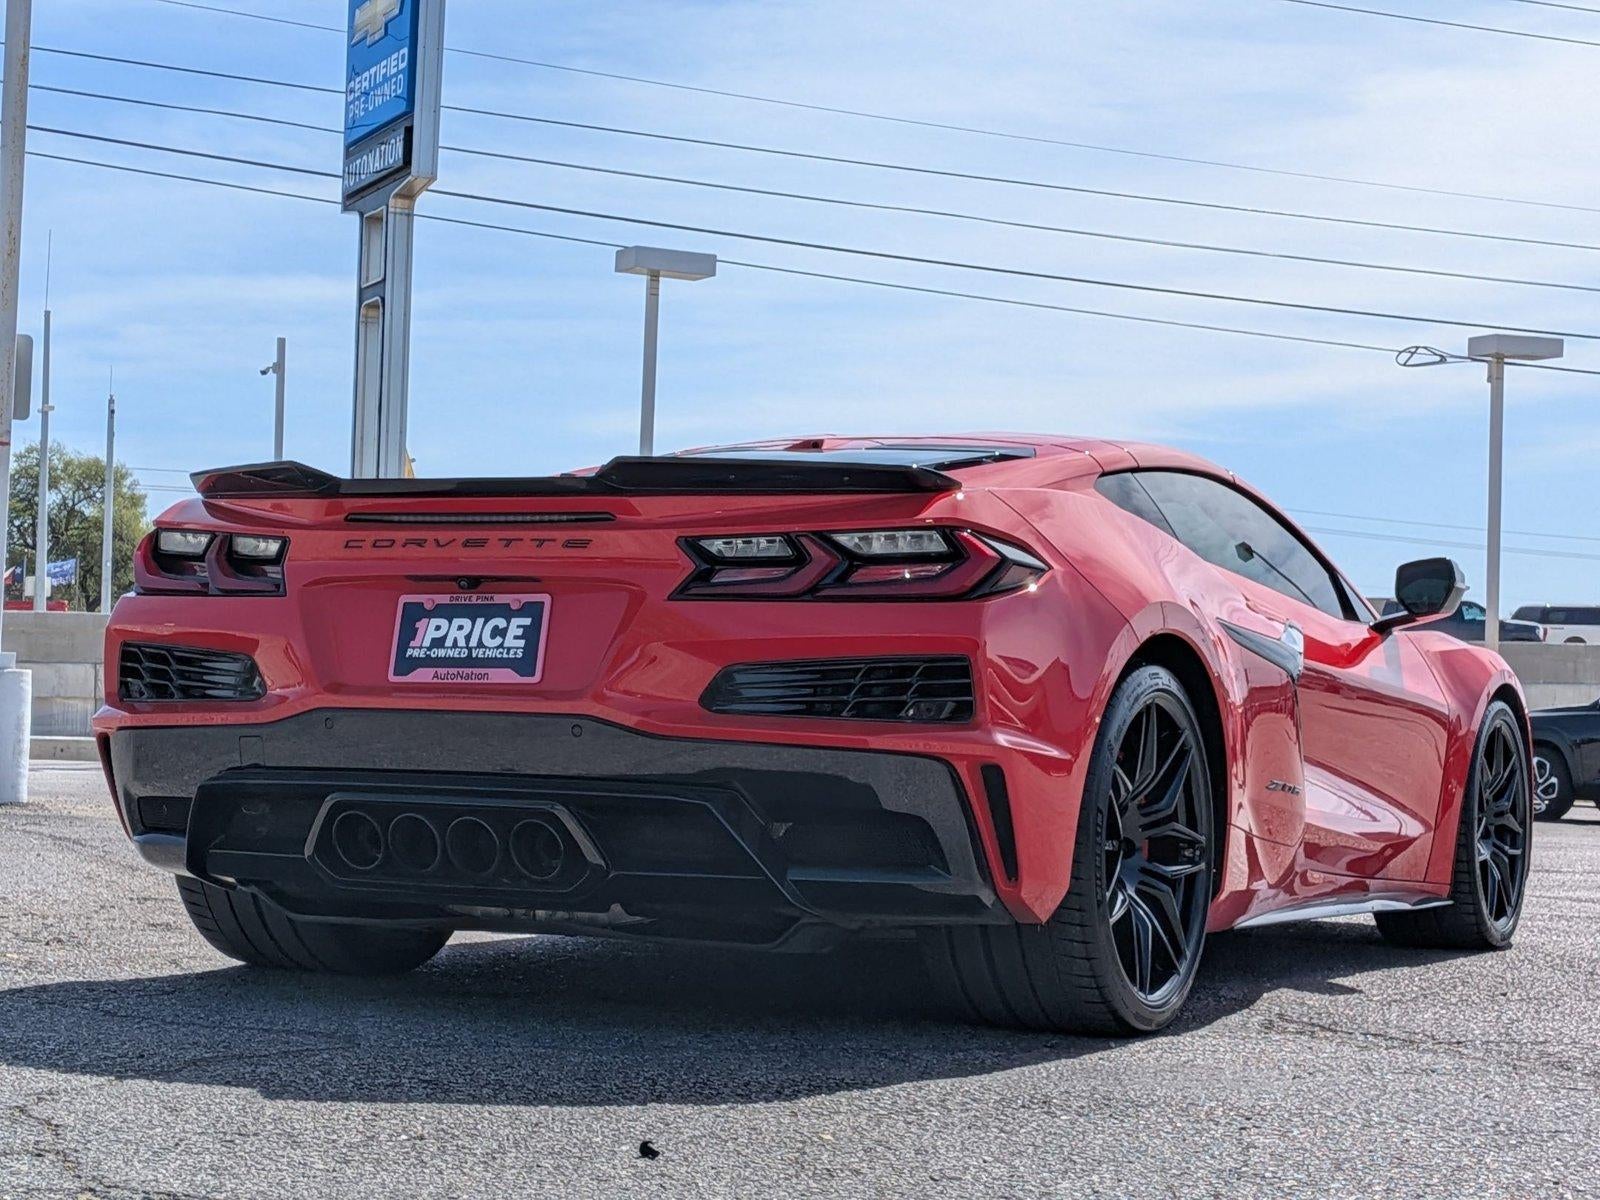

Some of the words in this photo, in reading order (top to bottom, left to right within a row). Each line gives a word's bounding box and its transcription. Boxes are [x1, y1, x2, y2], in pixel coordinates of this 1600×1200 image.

[347, 48, 408, 101] CERTIFIED
[349, 74, 403, 120] PRE-OWNED
[344, 538, 593, 549] CORVETTE
[449, 595, 473, 603] DRIVE
[475, 594, 495, 603] PINK
[405, 648, 468, 658] PRE-OWNED
[471, 648, 524, 658] VEHICLES
[432, 670, 489, 681] AutoNation
